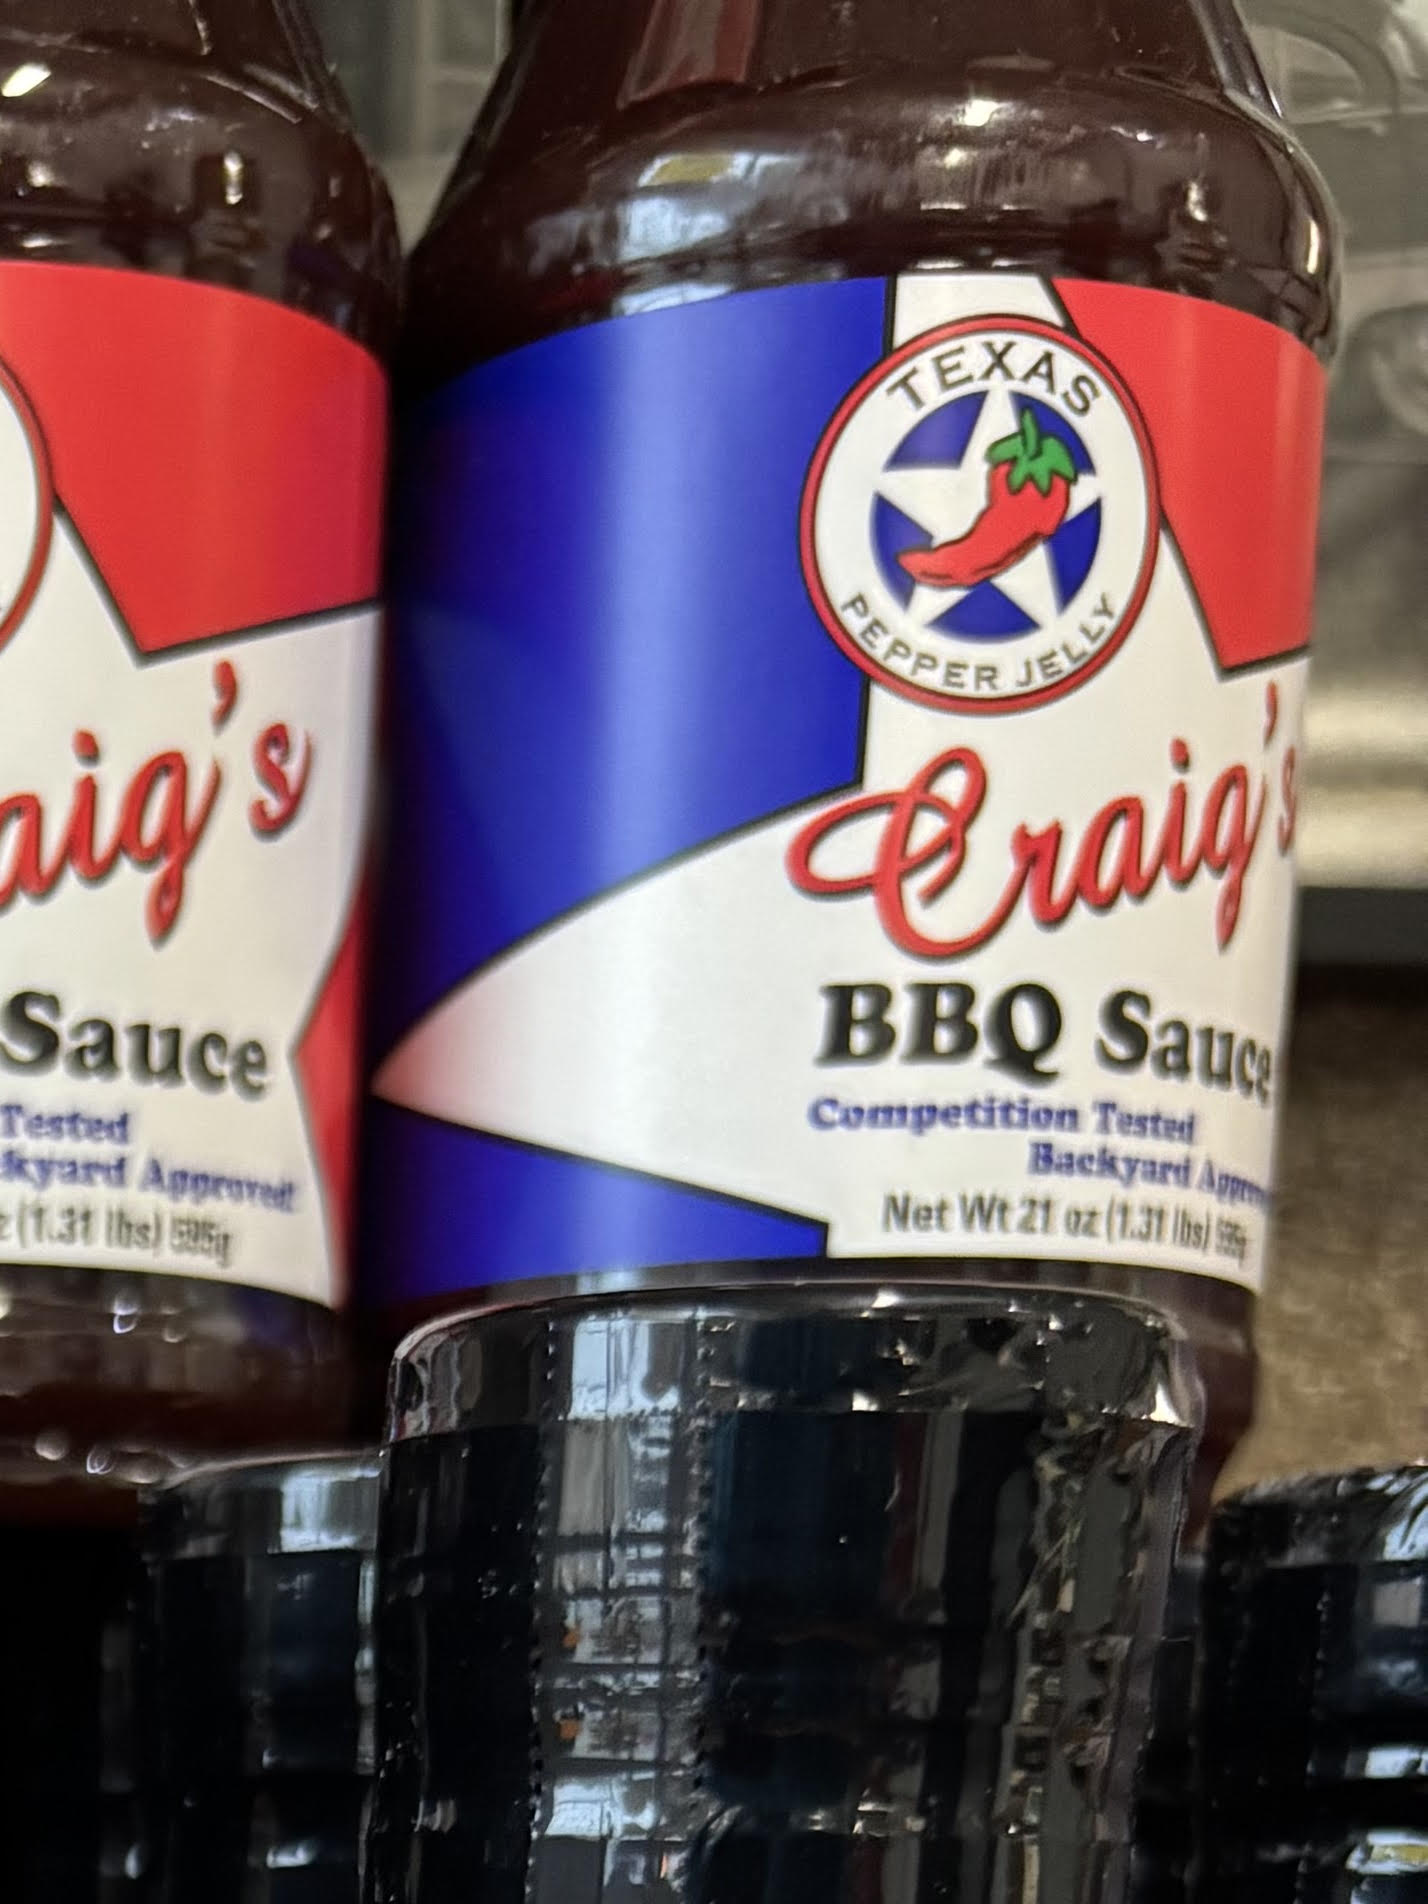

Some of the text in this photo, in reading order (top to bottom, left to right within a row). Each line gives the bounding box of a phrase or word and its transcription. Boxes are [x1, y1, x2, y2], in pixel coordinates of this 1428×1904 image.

[884, 340, 1101, 418] TEXAS
[840, 591, 1116, 691] PEPPER JELLY
[813, 981, 1272, 1108] BBQ Sauce
[0, 1104, 130, 1144] Tested
[807, 1096, 1195, 1145] Competition Tested
[1028, 1139, 1189, 1190] Backyard
[17, 1204, 93, 1249] (1.31
[105, 1211, 162, 1252] lbs)
[881, 1195, 947, 1234] Net
[959, 1196, 1007, 1235] Wt
[1015, 1198, 1052, 1233] 21
[1064, 1207, 1098, 1239] oz
[1106, 1201, 1164, 1244] (1.31
[1172, 1206, 1210, 1251] lbs)
